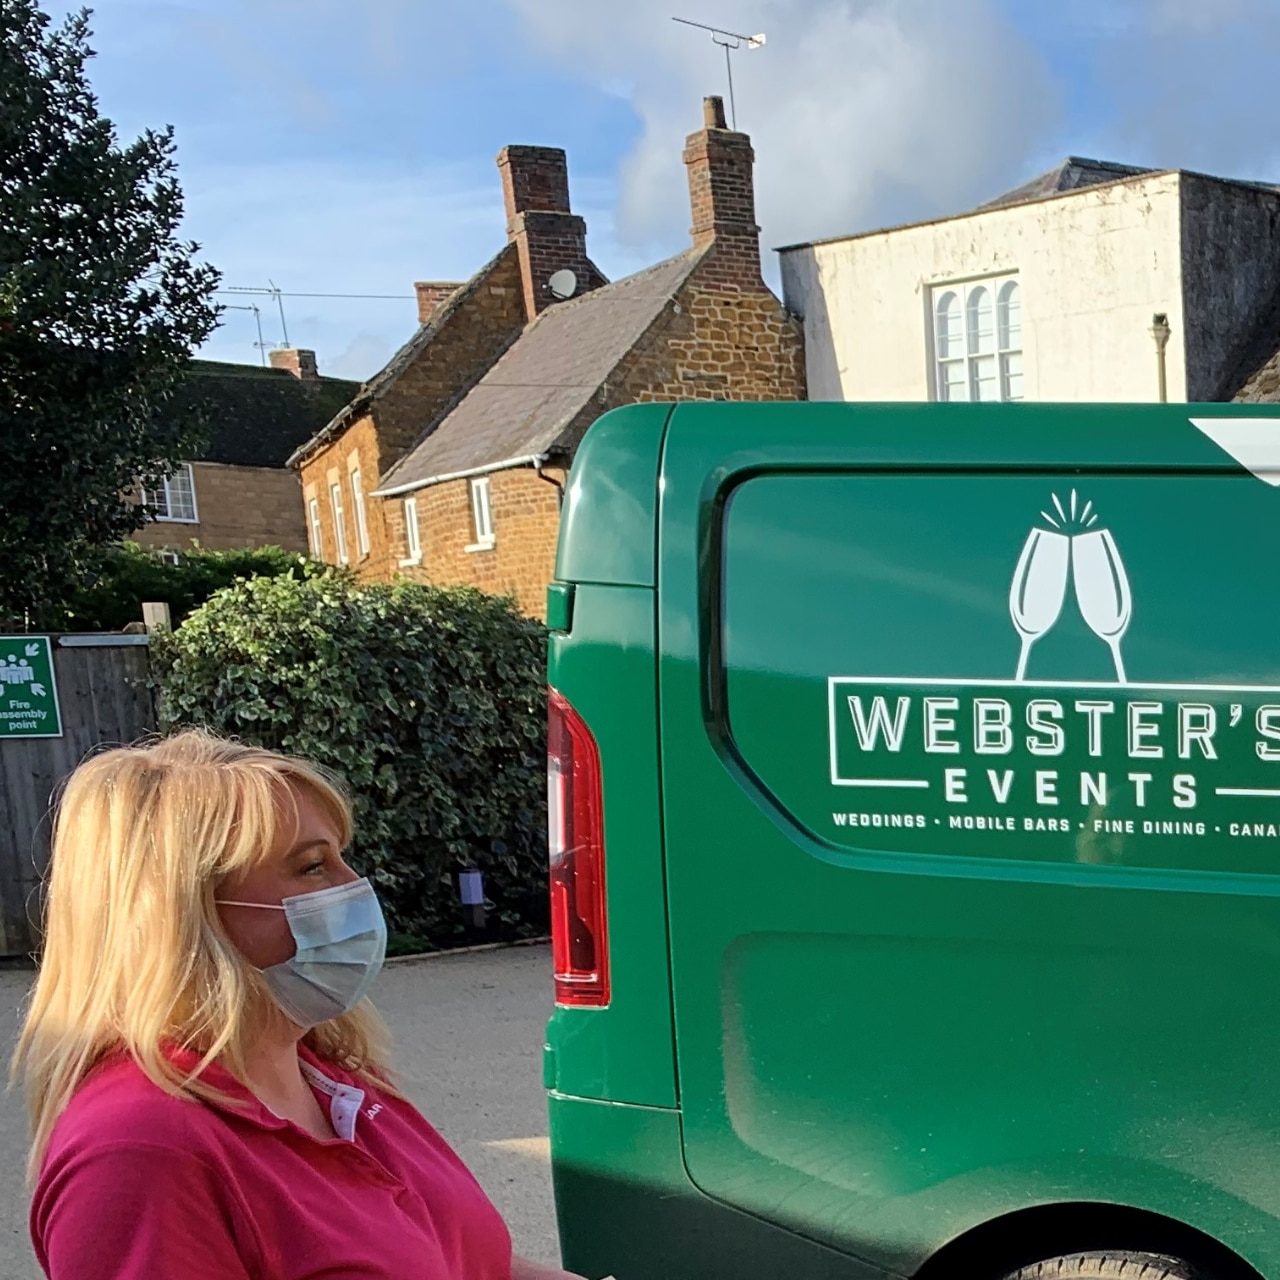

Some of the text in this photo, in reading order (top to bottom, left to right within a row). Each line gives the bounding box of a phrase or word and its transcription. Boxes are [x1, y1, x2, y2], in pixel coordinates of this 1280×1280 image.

[9, 700, 30, 709] Fire
[9, 720, 37, 731] point
[944, 768, 1197, 808] EVENTS
[832, 813, 926, 828] WEDDINGS
[950, 816, 1016, 831] MOBILE
[1023, 818, 1070, 832] BARS
[1094, 820, 1135, 834] FINE
[1143, 821, 1206, 835] DINING
